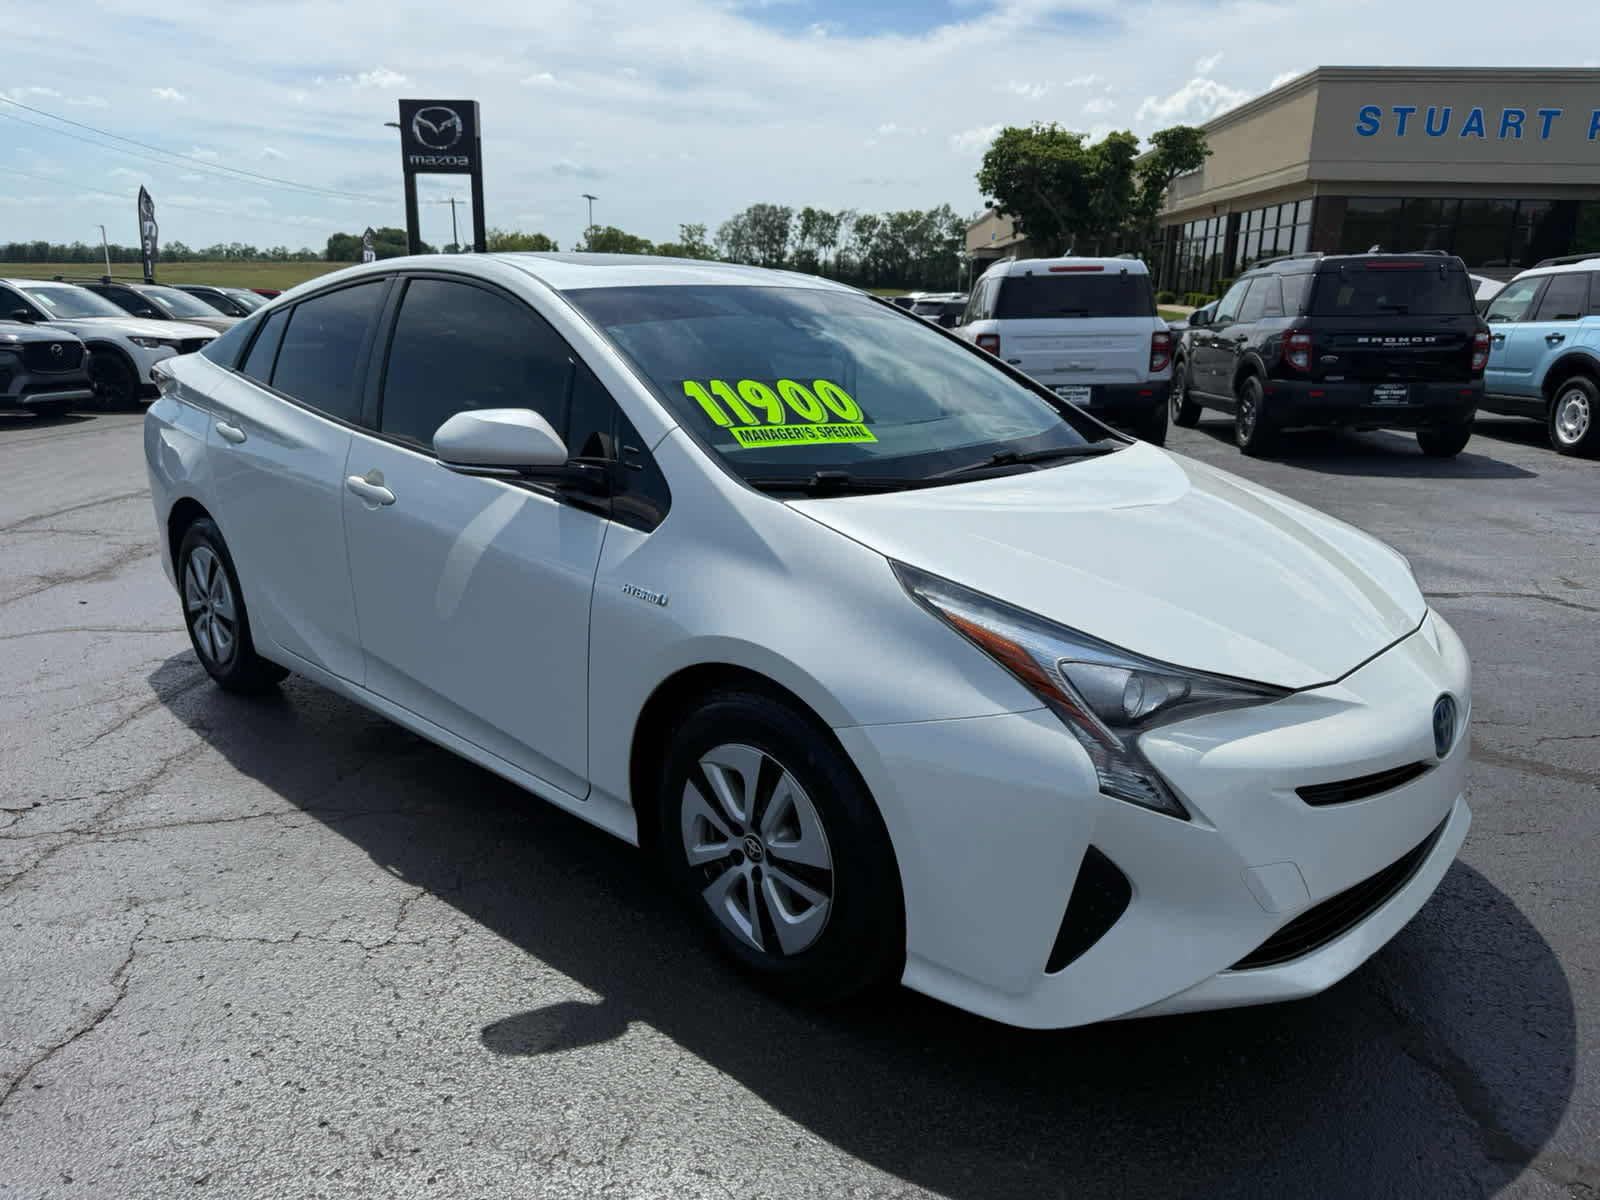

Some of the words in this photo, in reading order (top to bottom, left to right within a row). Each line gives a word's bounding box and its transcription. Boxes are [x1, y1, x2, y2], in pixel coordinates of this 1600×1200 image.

[1355, 104, 1563, 140] STUART
[683, 379, 864, 427] 11900
[738, 427, 816, 443] MANAGER'S
[816, 425, 868, 439] SPECIAL
[622, 583, 659, 604] HYBRID
